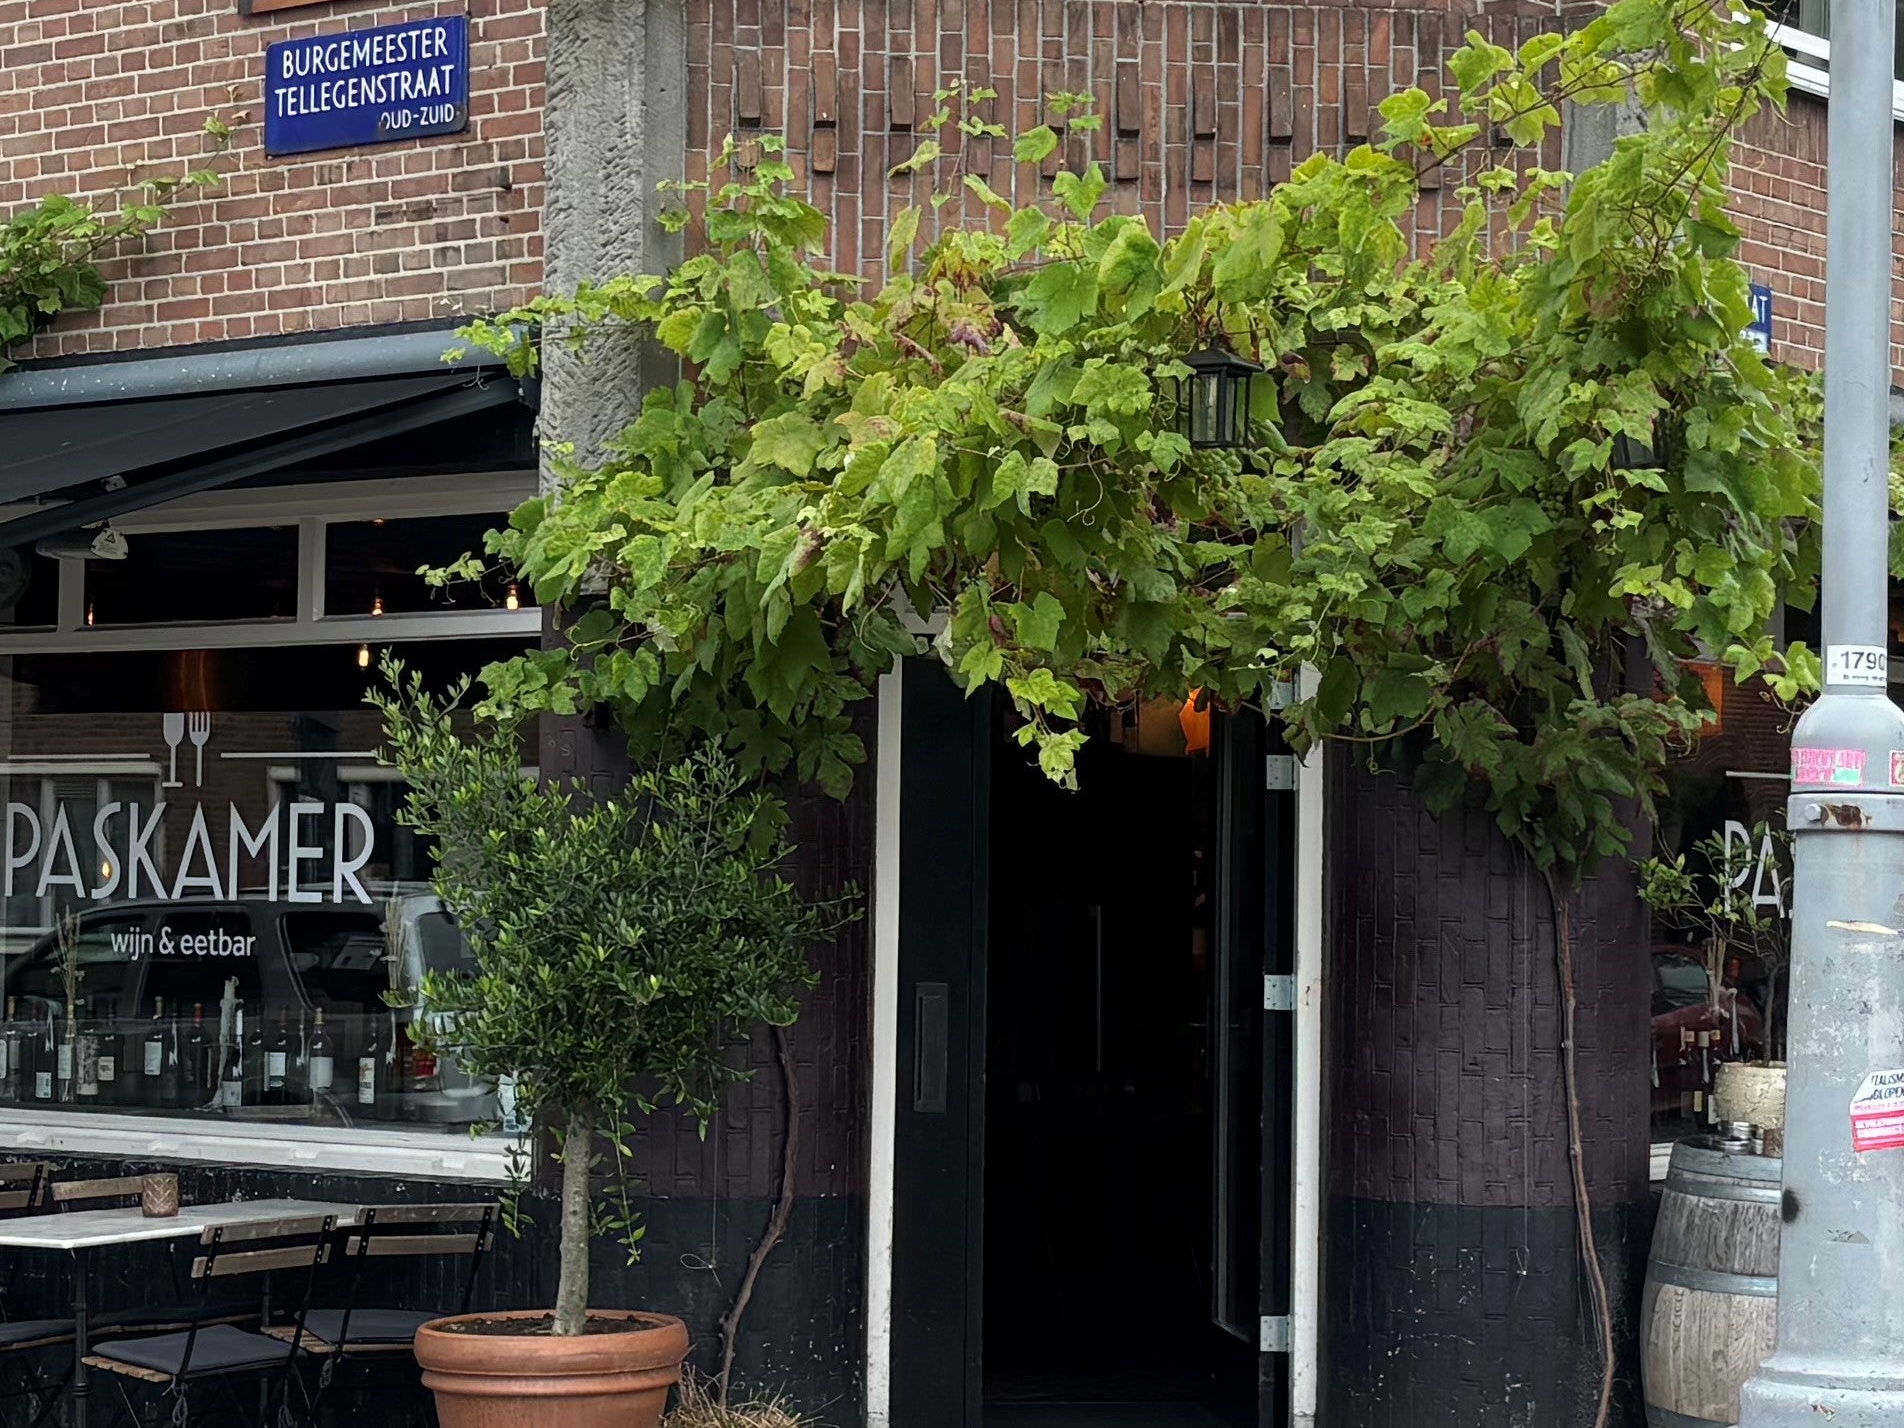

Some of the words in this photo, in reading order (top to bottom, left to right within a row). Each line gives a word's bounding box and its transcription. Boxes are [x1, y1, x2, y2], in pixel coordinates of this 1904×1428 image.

[283, 27, 448, 79] BURGEMEESTER
[275, 65, 455, 117] TELLEGENSTRAAT
[379, 104, 455, 129] OUD-ZUID
[4, 800, 374, 904] PASKAMER
[111, 928, 155, 961] wijn
[158, 927, 175, 955] &
[179, 926, 257, 957] eetbar
